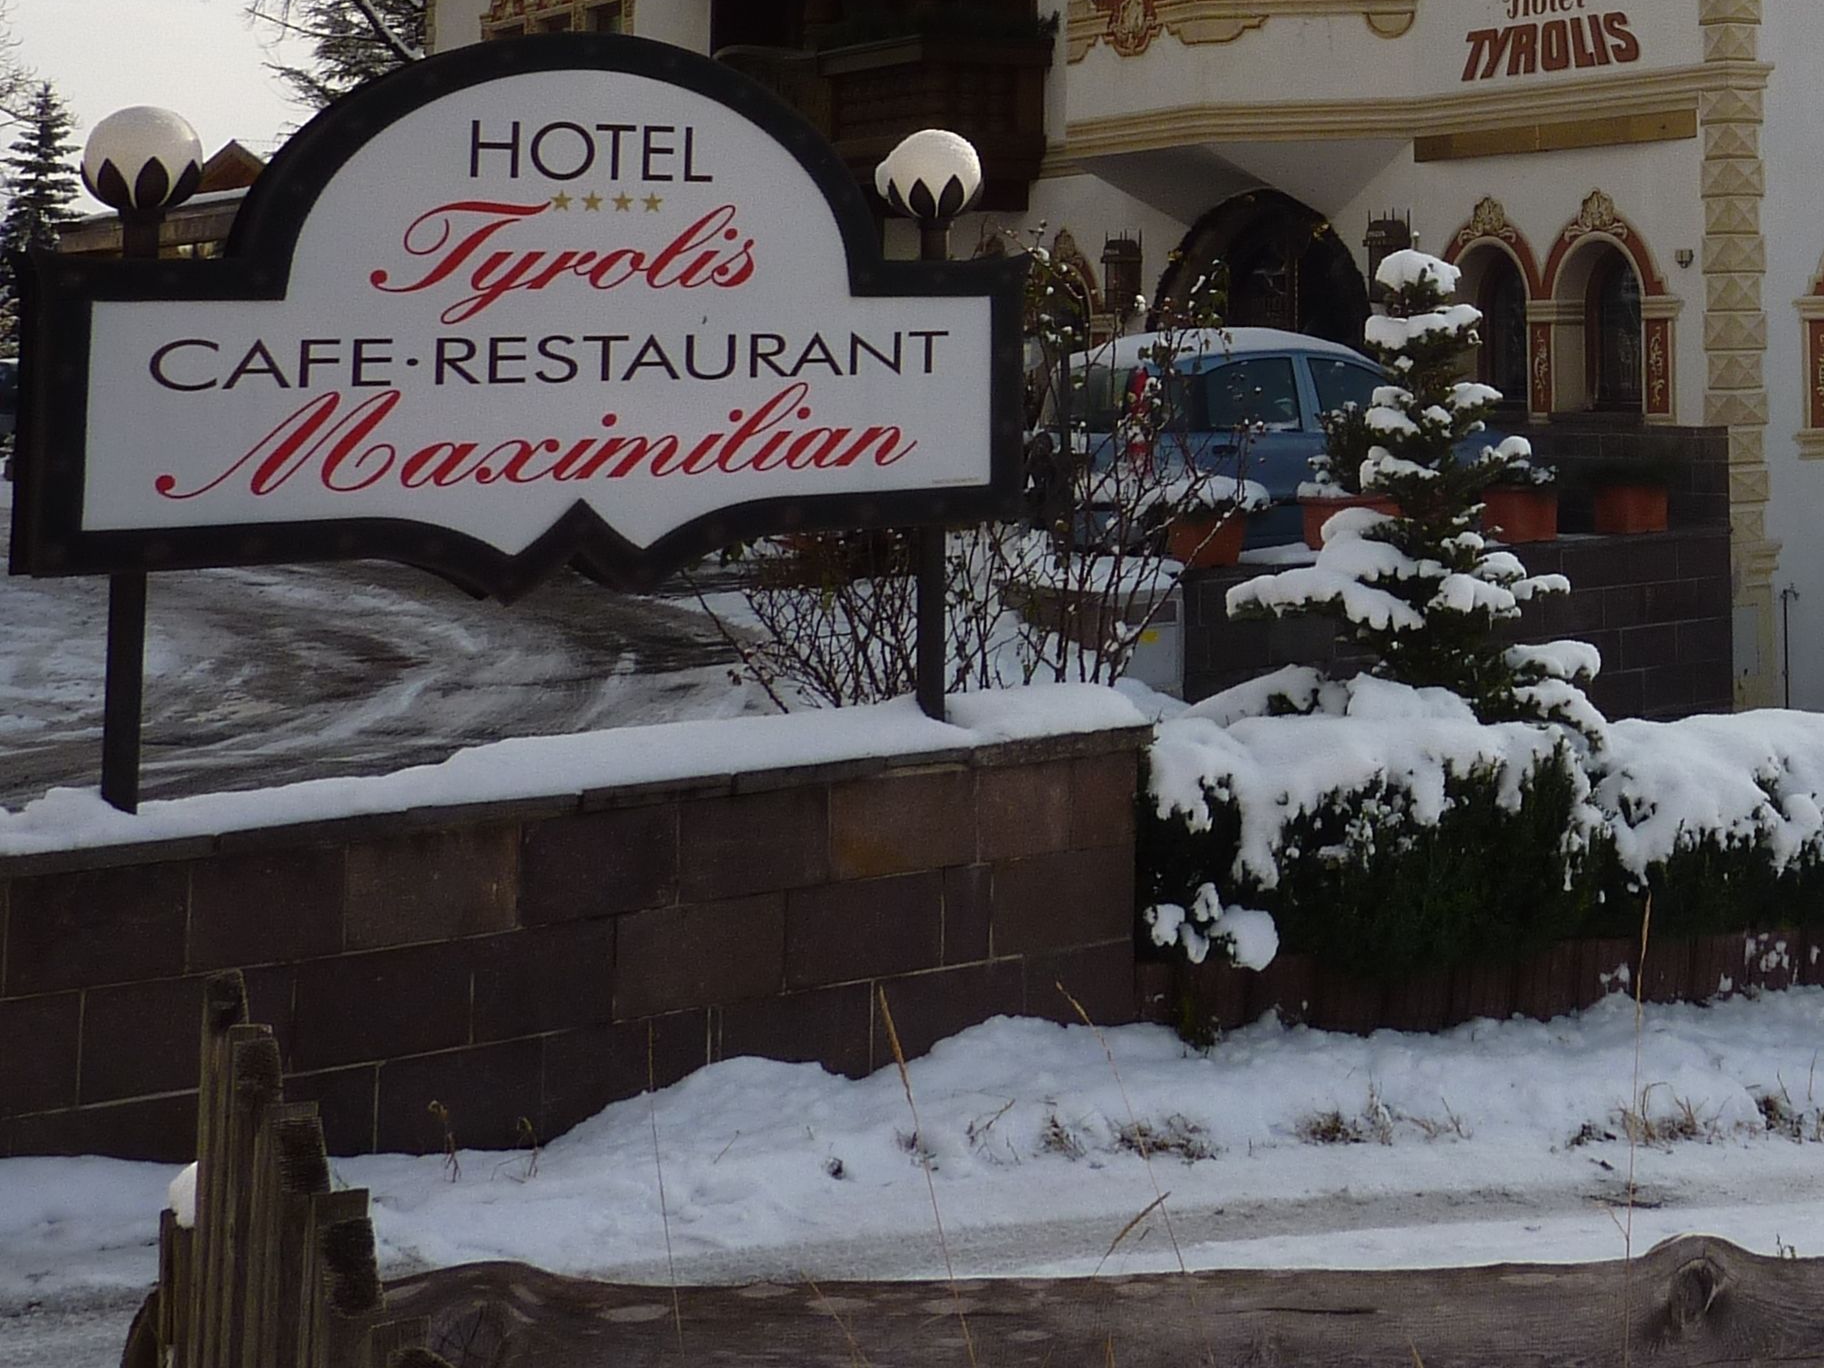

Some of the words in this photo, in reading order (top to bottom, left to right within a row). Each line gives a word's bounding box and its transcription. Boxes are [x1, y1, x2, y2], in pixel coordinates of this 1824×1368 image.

[1461, 11, 1640, 81] TYROLIS
[469, 120, 713, 182] HOTEL
[370, 200, 754, 325] Tyrolis
[155, 381, 918, 500] Maximilian
